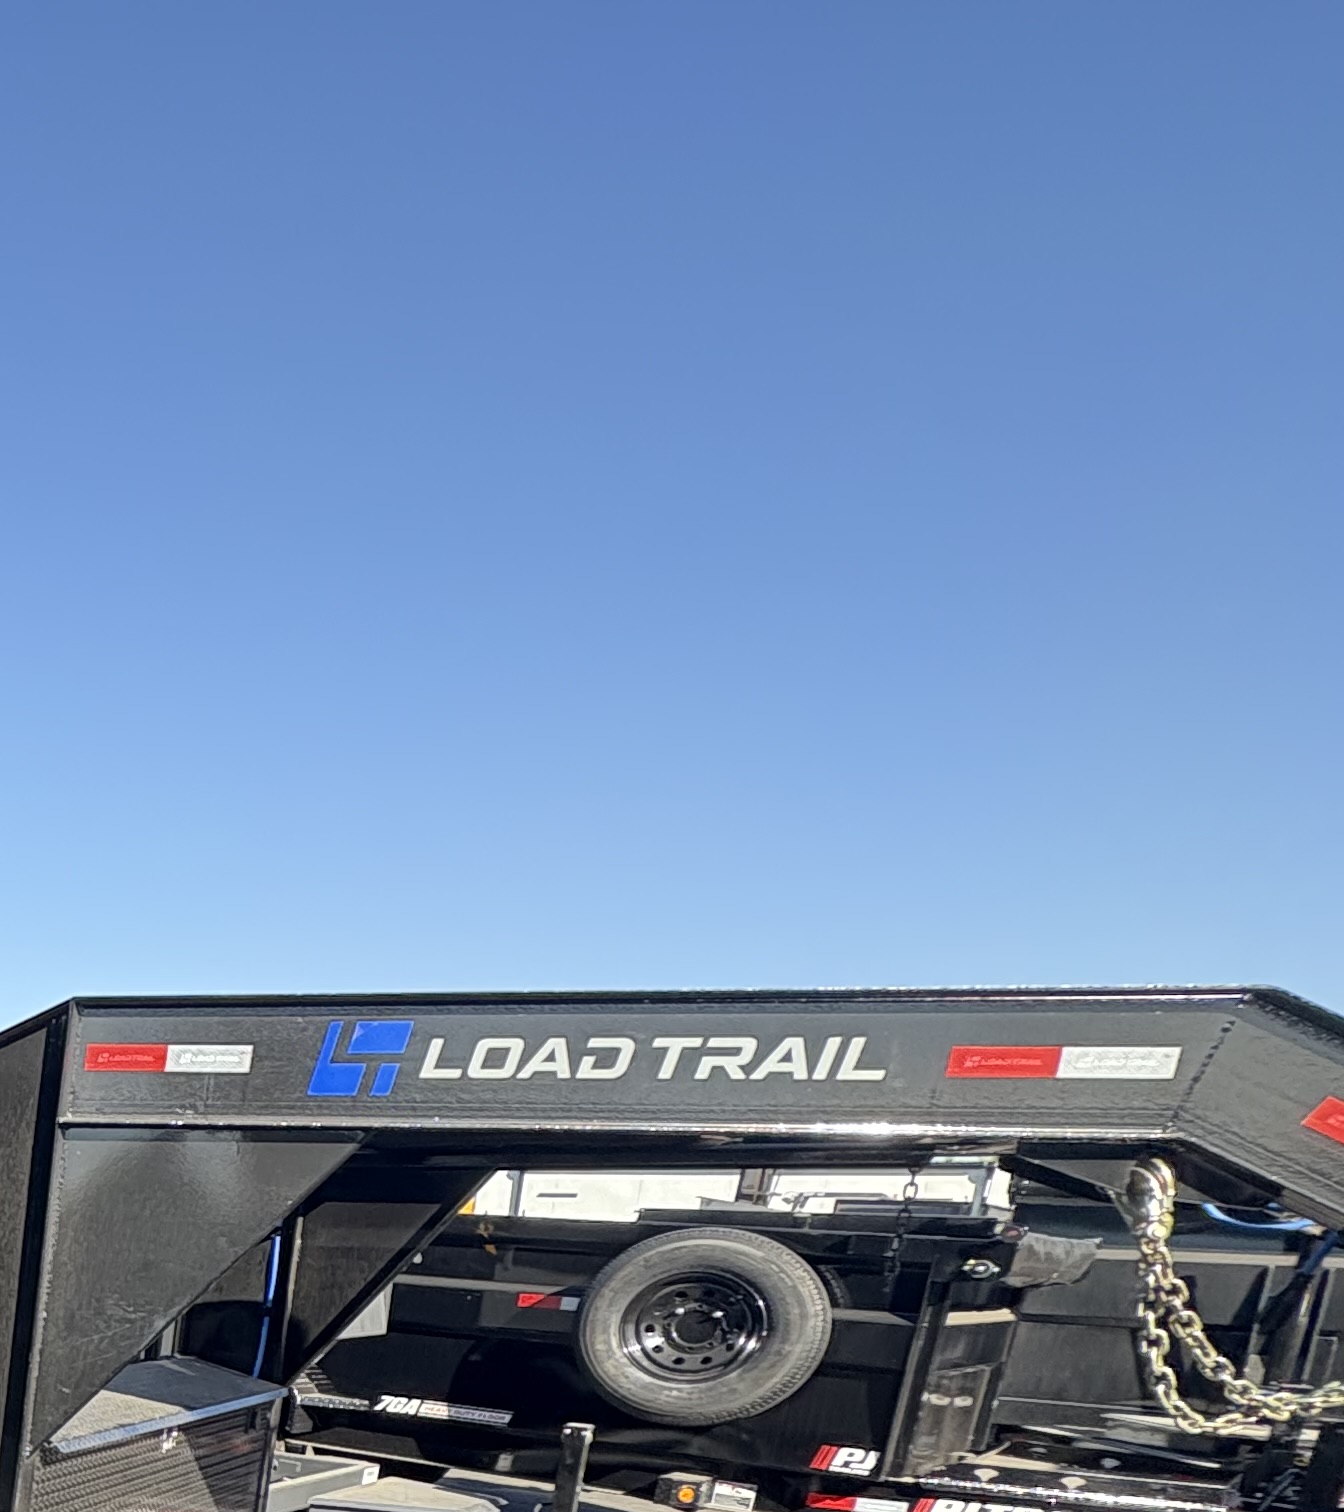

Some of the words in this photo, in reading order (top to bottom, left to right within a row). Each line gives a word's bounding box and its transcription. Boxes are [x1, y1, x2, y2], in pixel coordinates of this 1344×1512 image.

[418, 1037, 636, 1080] LOAD
[652, 1036, 887, 1081] TRAIL
[373, 1395, 422, 1415] 7GA
[832, 1447, 880, 1470] PJ
